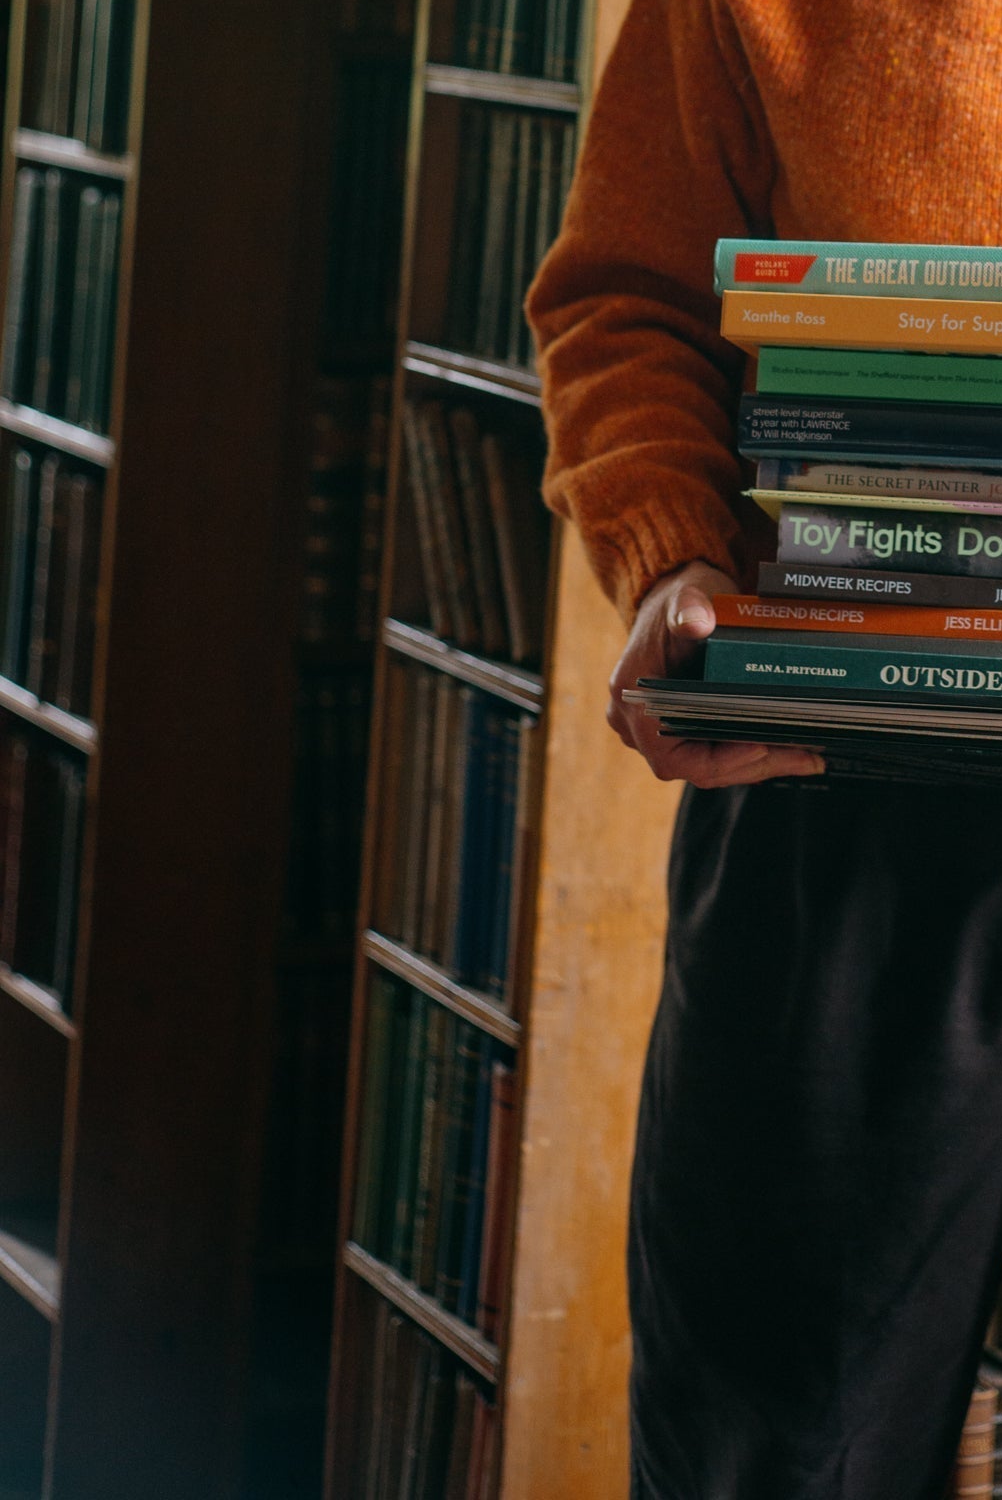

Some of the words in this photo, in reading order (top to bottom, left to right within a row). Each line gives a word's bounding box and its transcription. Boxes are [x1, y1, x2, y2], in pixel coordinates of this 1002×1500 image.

[825, 257, 858, 284] THE
[862, 258, 919, 286] GREAT
[742, 309, 790, 325] Xanthe
[795, 312, 826, 325] Ross
[898, 312, 936, 334] Stay
[941, 314, 967, 331] for
[802, 410, 845, 419] superstar
[751, 419, 758, 427] a
[760, 420, 779, 428] year
[781, 420, 799, 428] with
[801, 420, 851, 431] LAWRENCE
[751, 429, 762, 439] by
[763, 430, 779, 438] Will
[781, 430, 832, 441] Hodgkinson
[825, 473, 855, 486] THE
[858, 475, 914, 490] SECRET
[918, 479, 980, 494] PAINTER
[789, 517, 842, 555] Toy
[848, 520, 942, 559] Fights
[784, 573, 854, 591] MIDWEEK
[856, 578, 912, 595] RECIPES
[737, 603, 807, 620] WEEKEND
[809, 607, 864, 624] RECIPES
[944, 616, 971, 631] JESS
[745, 663, 774, 673] SEAN
[774, 665, 784, 674] A.
[786, 665, 847, 677] PRITCHARD
